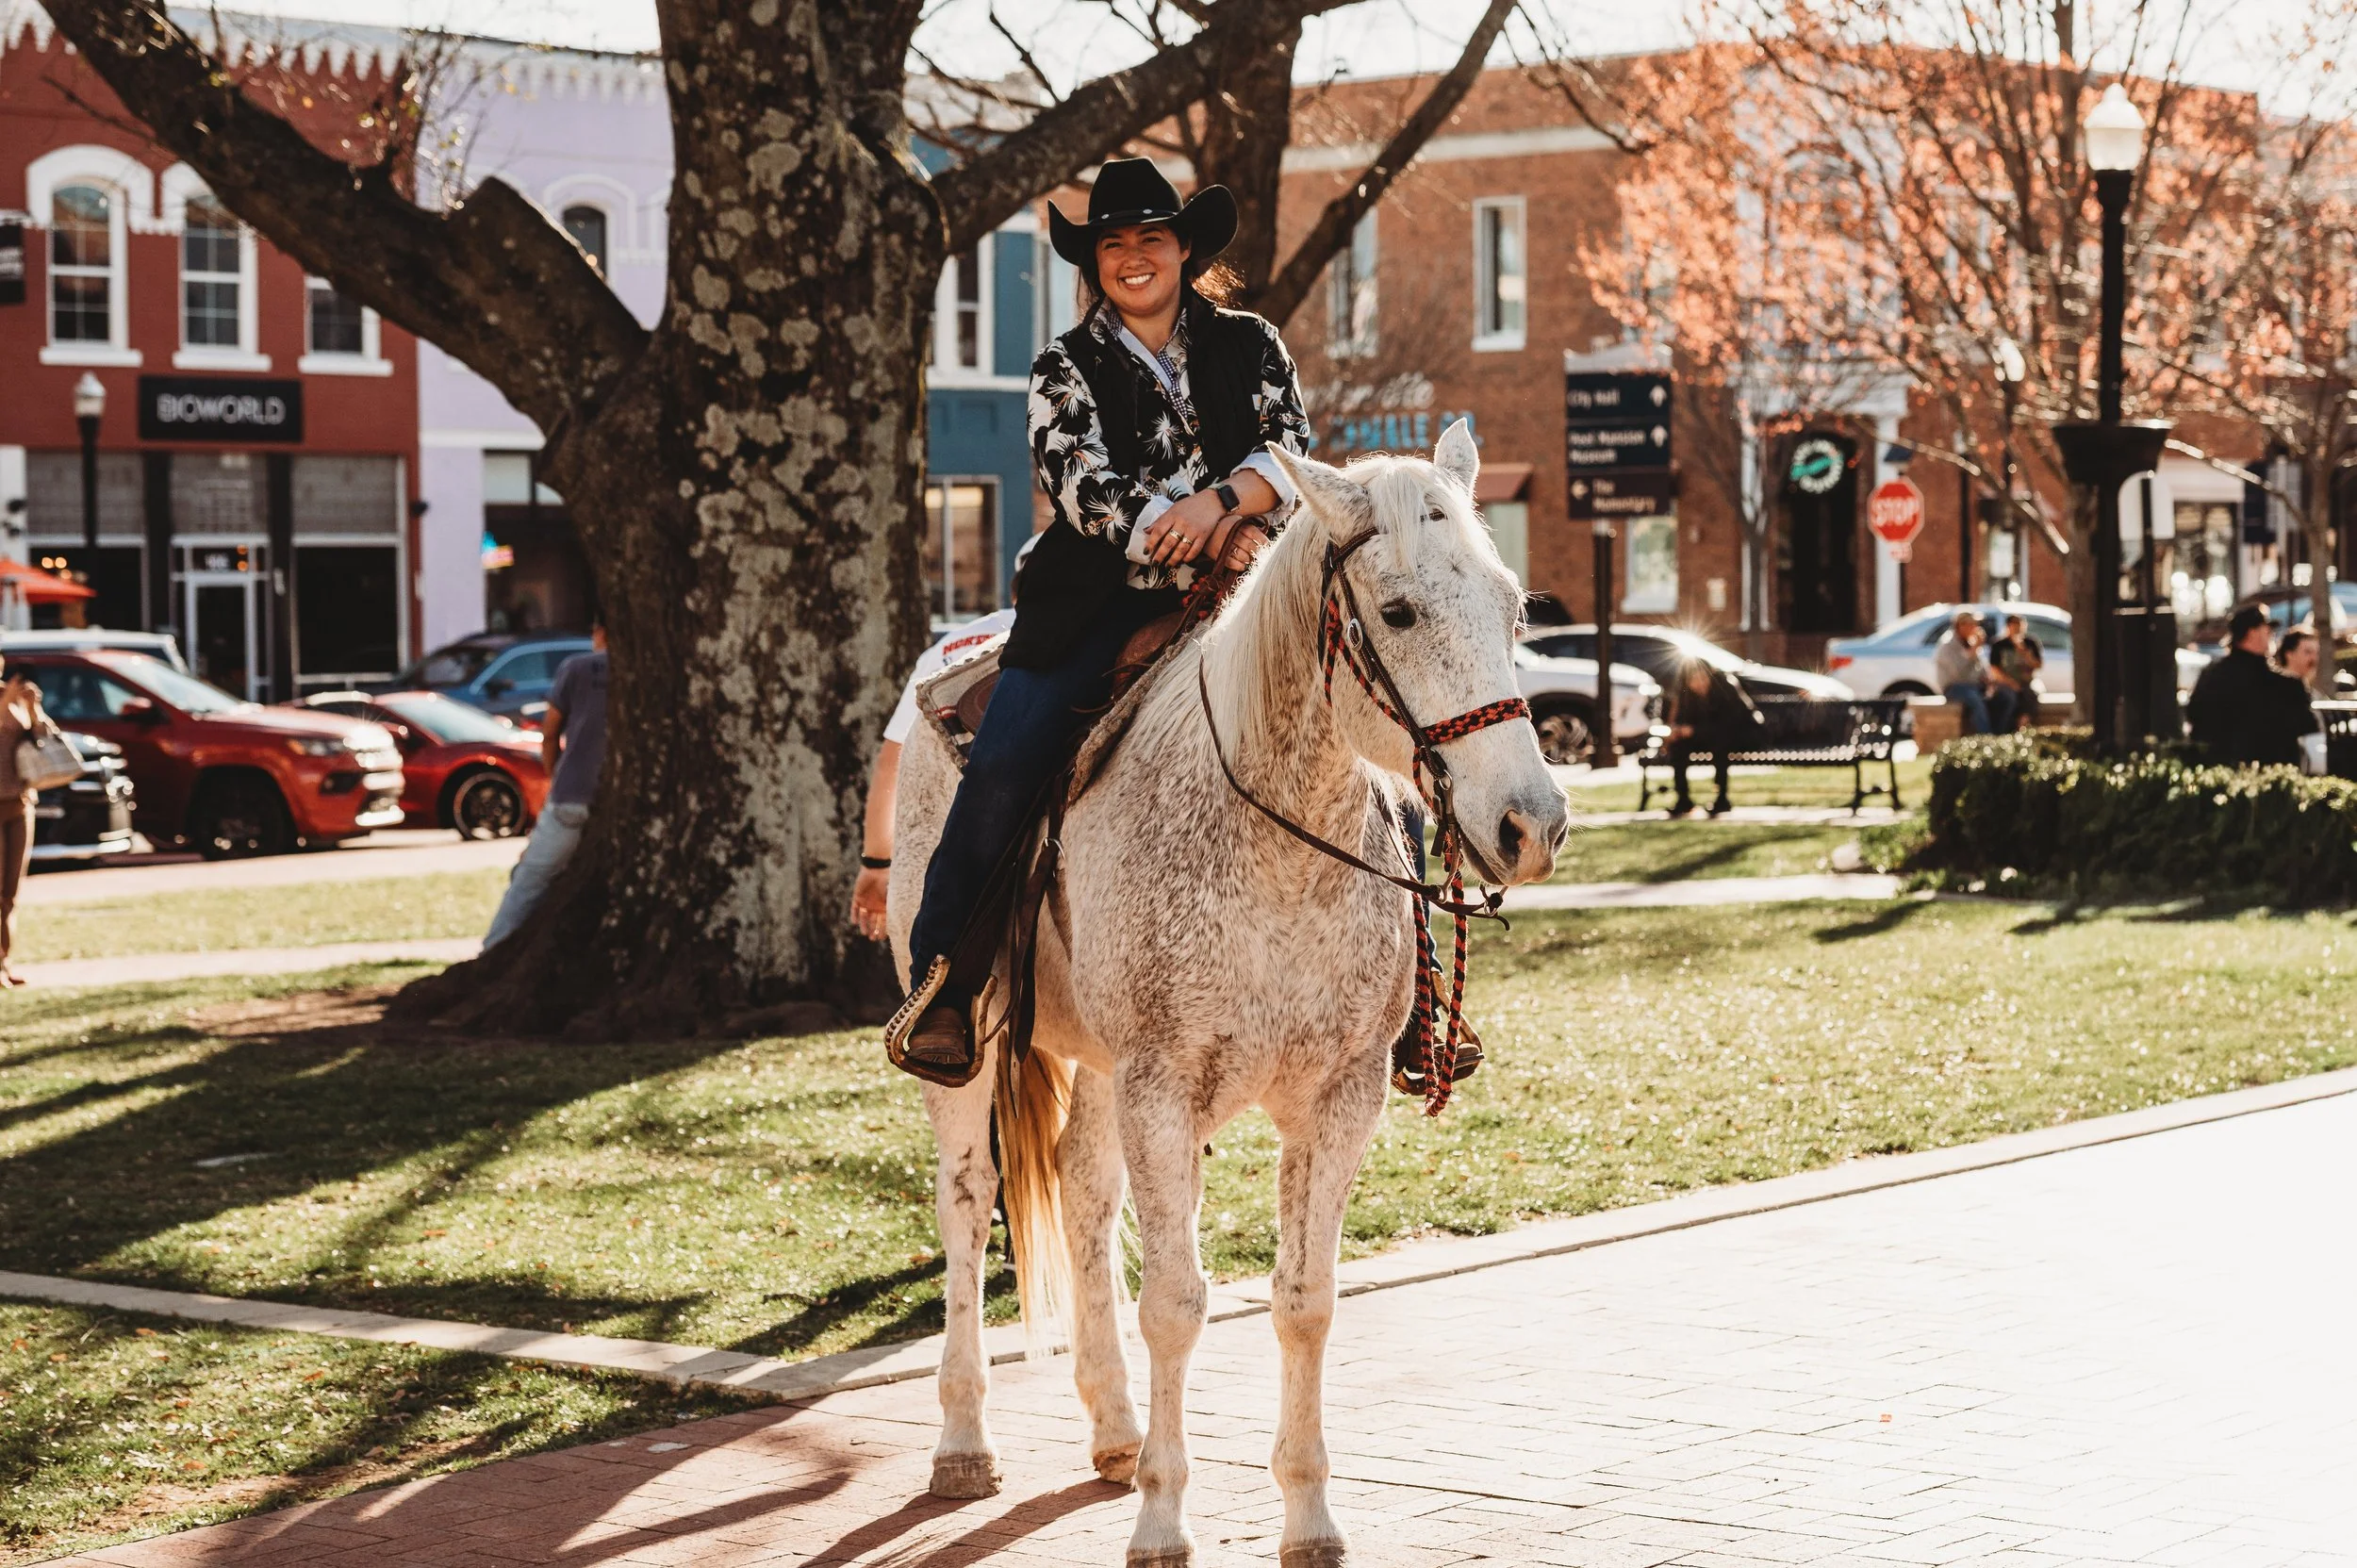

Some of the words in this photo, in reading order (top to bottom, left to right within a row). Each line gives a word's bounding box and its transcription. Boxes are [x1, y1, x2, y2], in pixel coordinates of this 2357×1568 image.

[1569, 389, 1591, 407] City
[1594, 388, 1620, 405] Hall
[158, 394, 285, 423] BIOWORLD
[1598, 430, 1645, 444] Mansion
[1570, 449, 1616, 463] Museum
[1593, 479, 1615, 494] The
[1873, 499, 1918, 525] STOP
